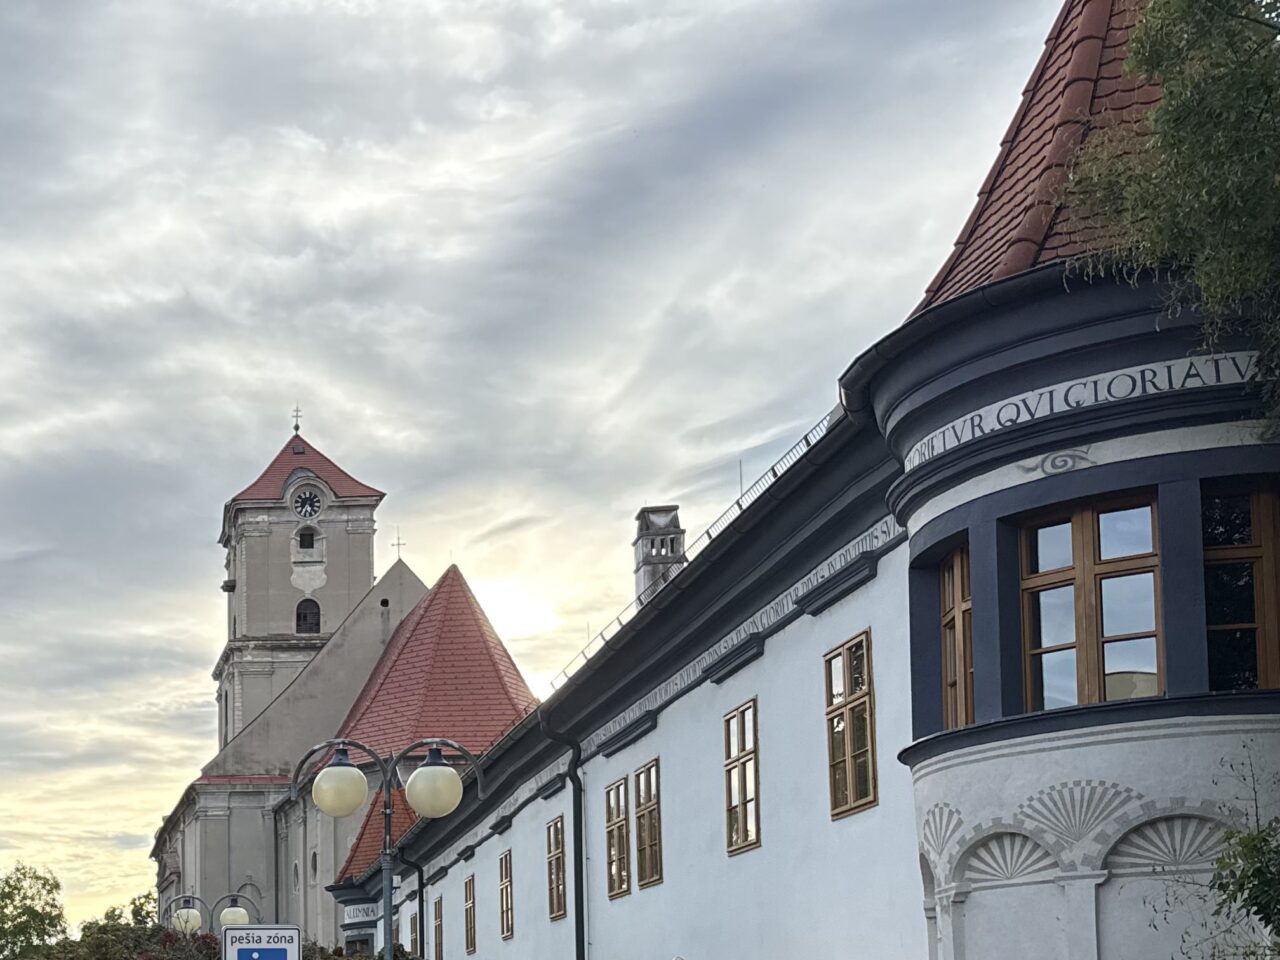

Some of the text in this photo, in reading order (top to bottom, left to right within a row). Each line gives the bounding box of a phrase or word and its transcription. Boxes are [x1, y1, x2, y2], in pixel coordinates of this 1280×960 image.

[996, 389, 1058, 428] QVI
[1063, 354, 1256, 409] GLORIATV
[230, 932, 294, 946] pešia zóna
